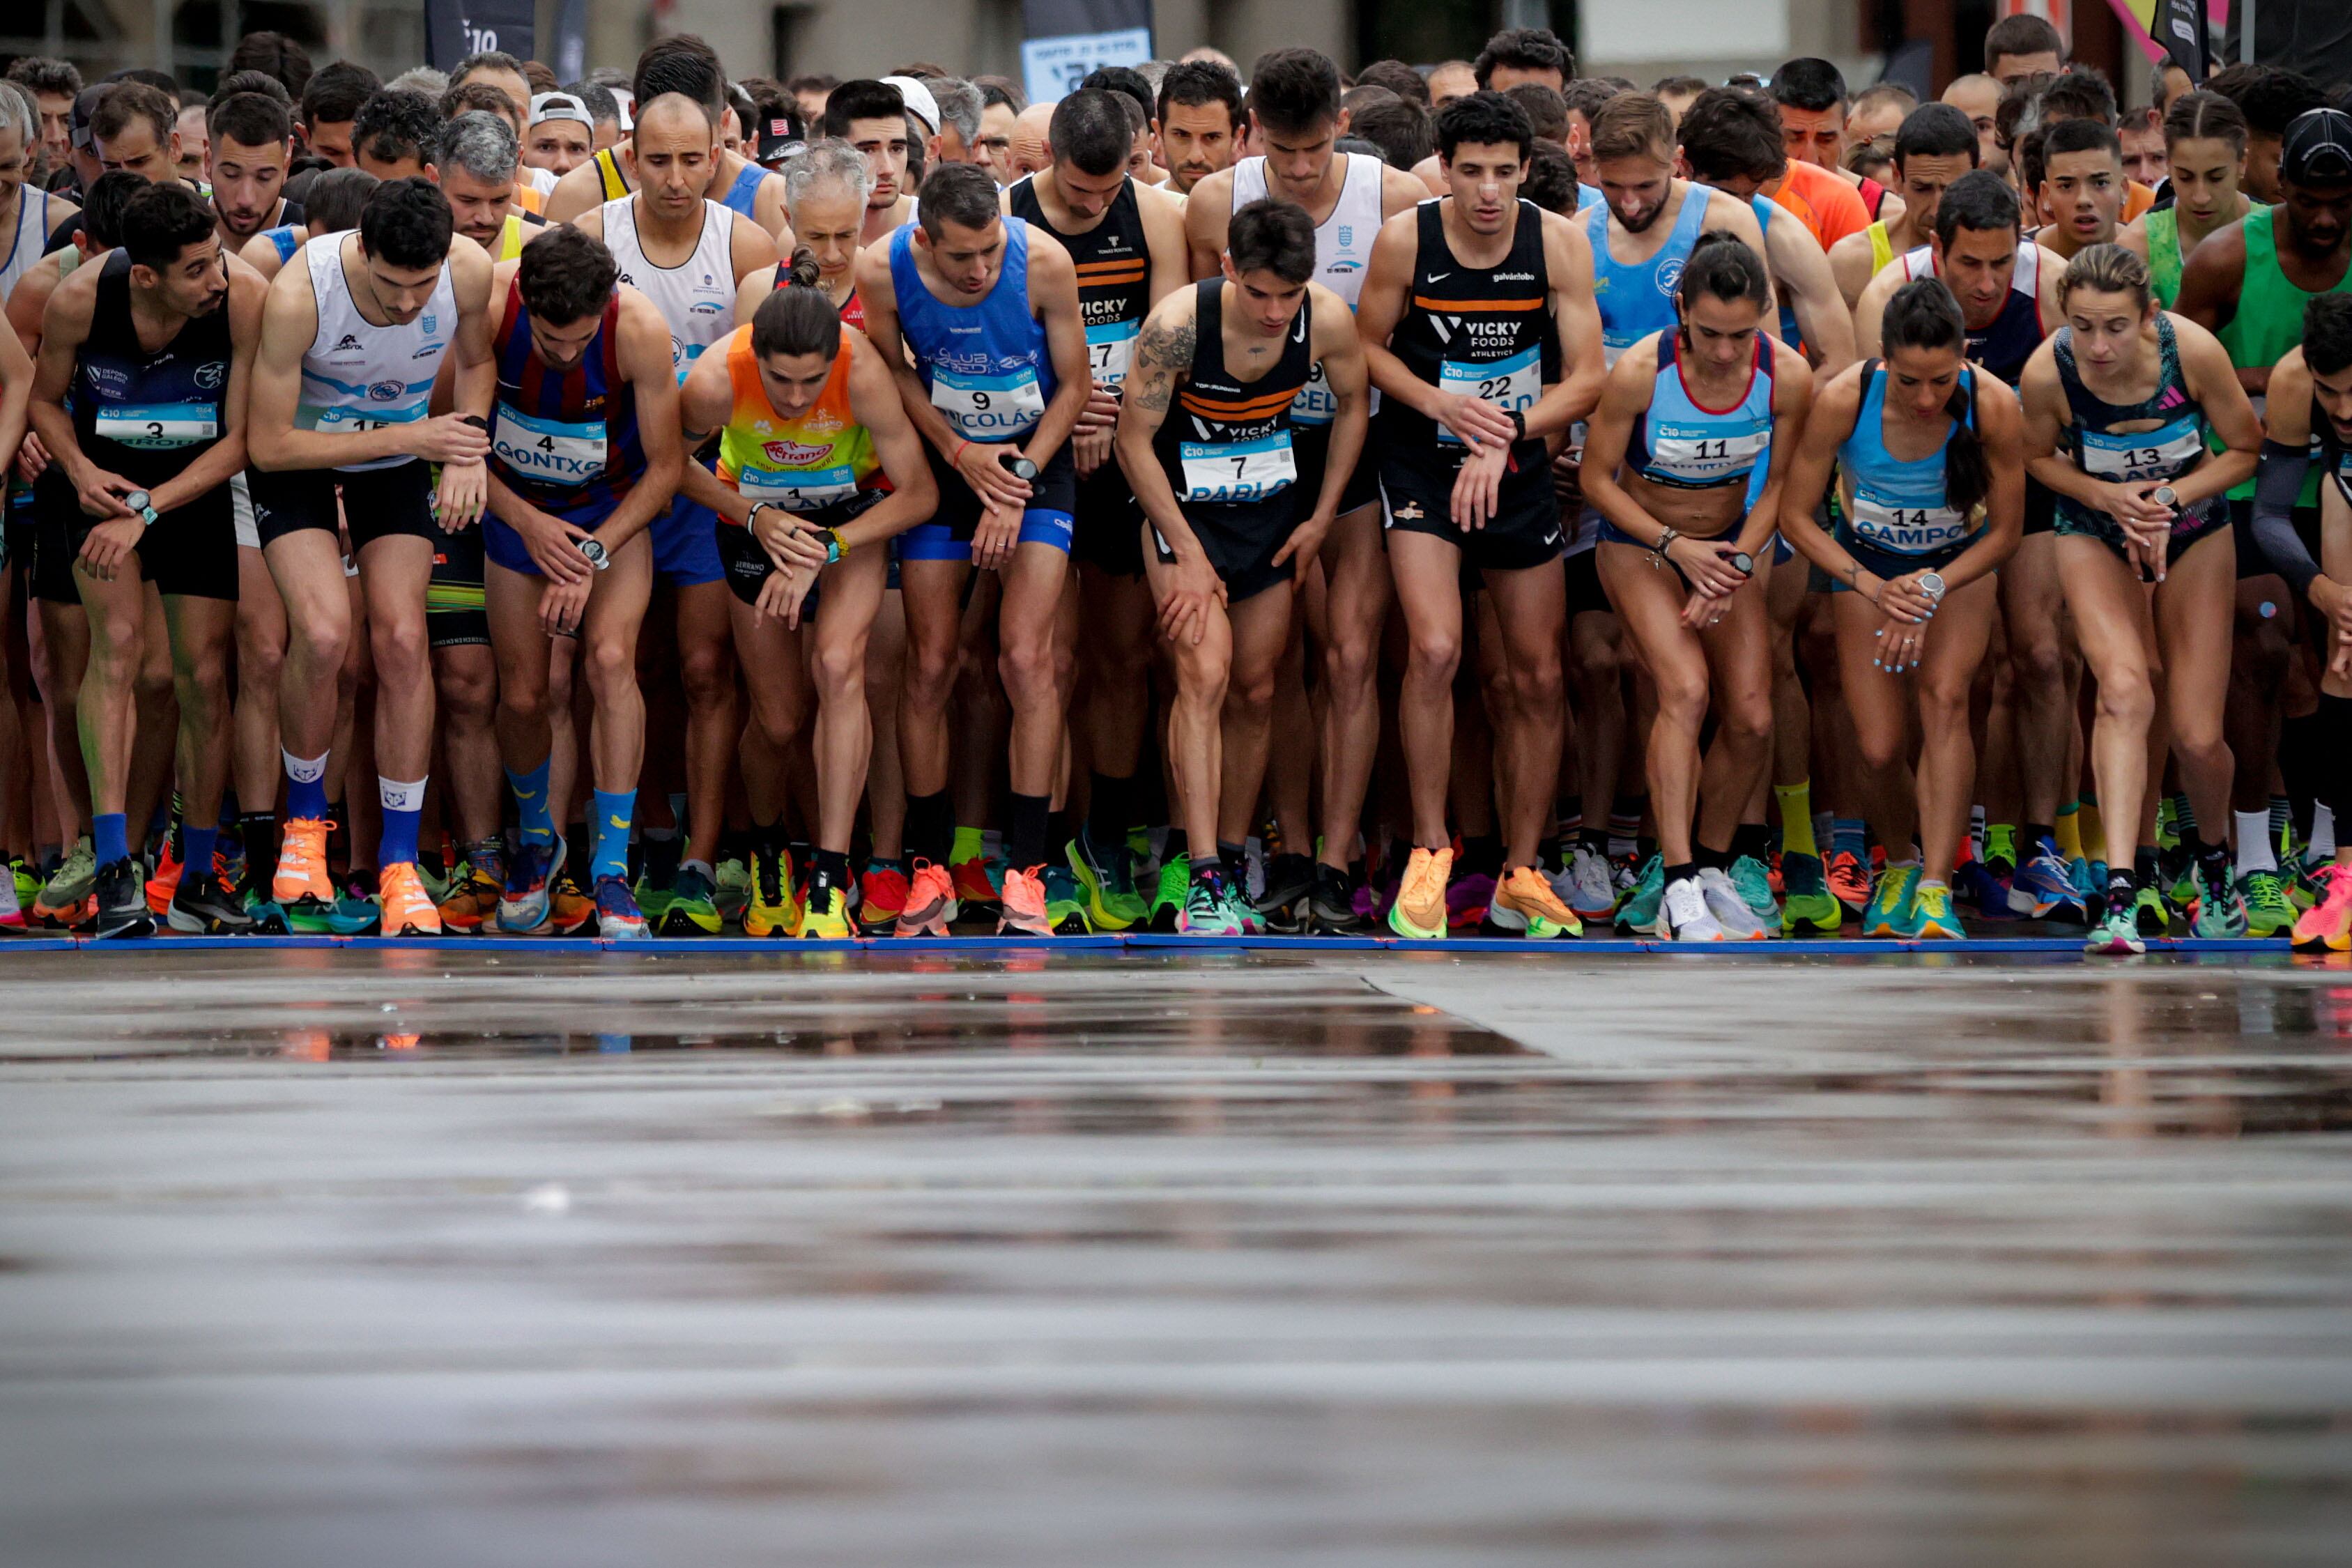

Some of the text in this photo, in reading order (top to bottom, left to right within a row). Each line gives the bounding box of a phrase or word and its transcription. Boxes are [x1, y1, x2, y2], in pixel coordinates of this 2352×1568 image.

[1466, 322, 1521, 335] VICKY
[1471, 337, 1514, 347] FOODS
[1479, 377, 1512, 399] 22
[972, 392, 990, 410] 9
[146, 422, 164, 440] 3
[1229, 416, 1277, 436] VICKY
[537, 436, 555, 453] 4
[1693, 440, 1730, 460] 11
[2123, 448, 2161, 468] 13
[1231, 456, 1247, 479] 7
[787, 488, 801, 500] 1
[1892, 509, 1928, 527] 14
